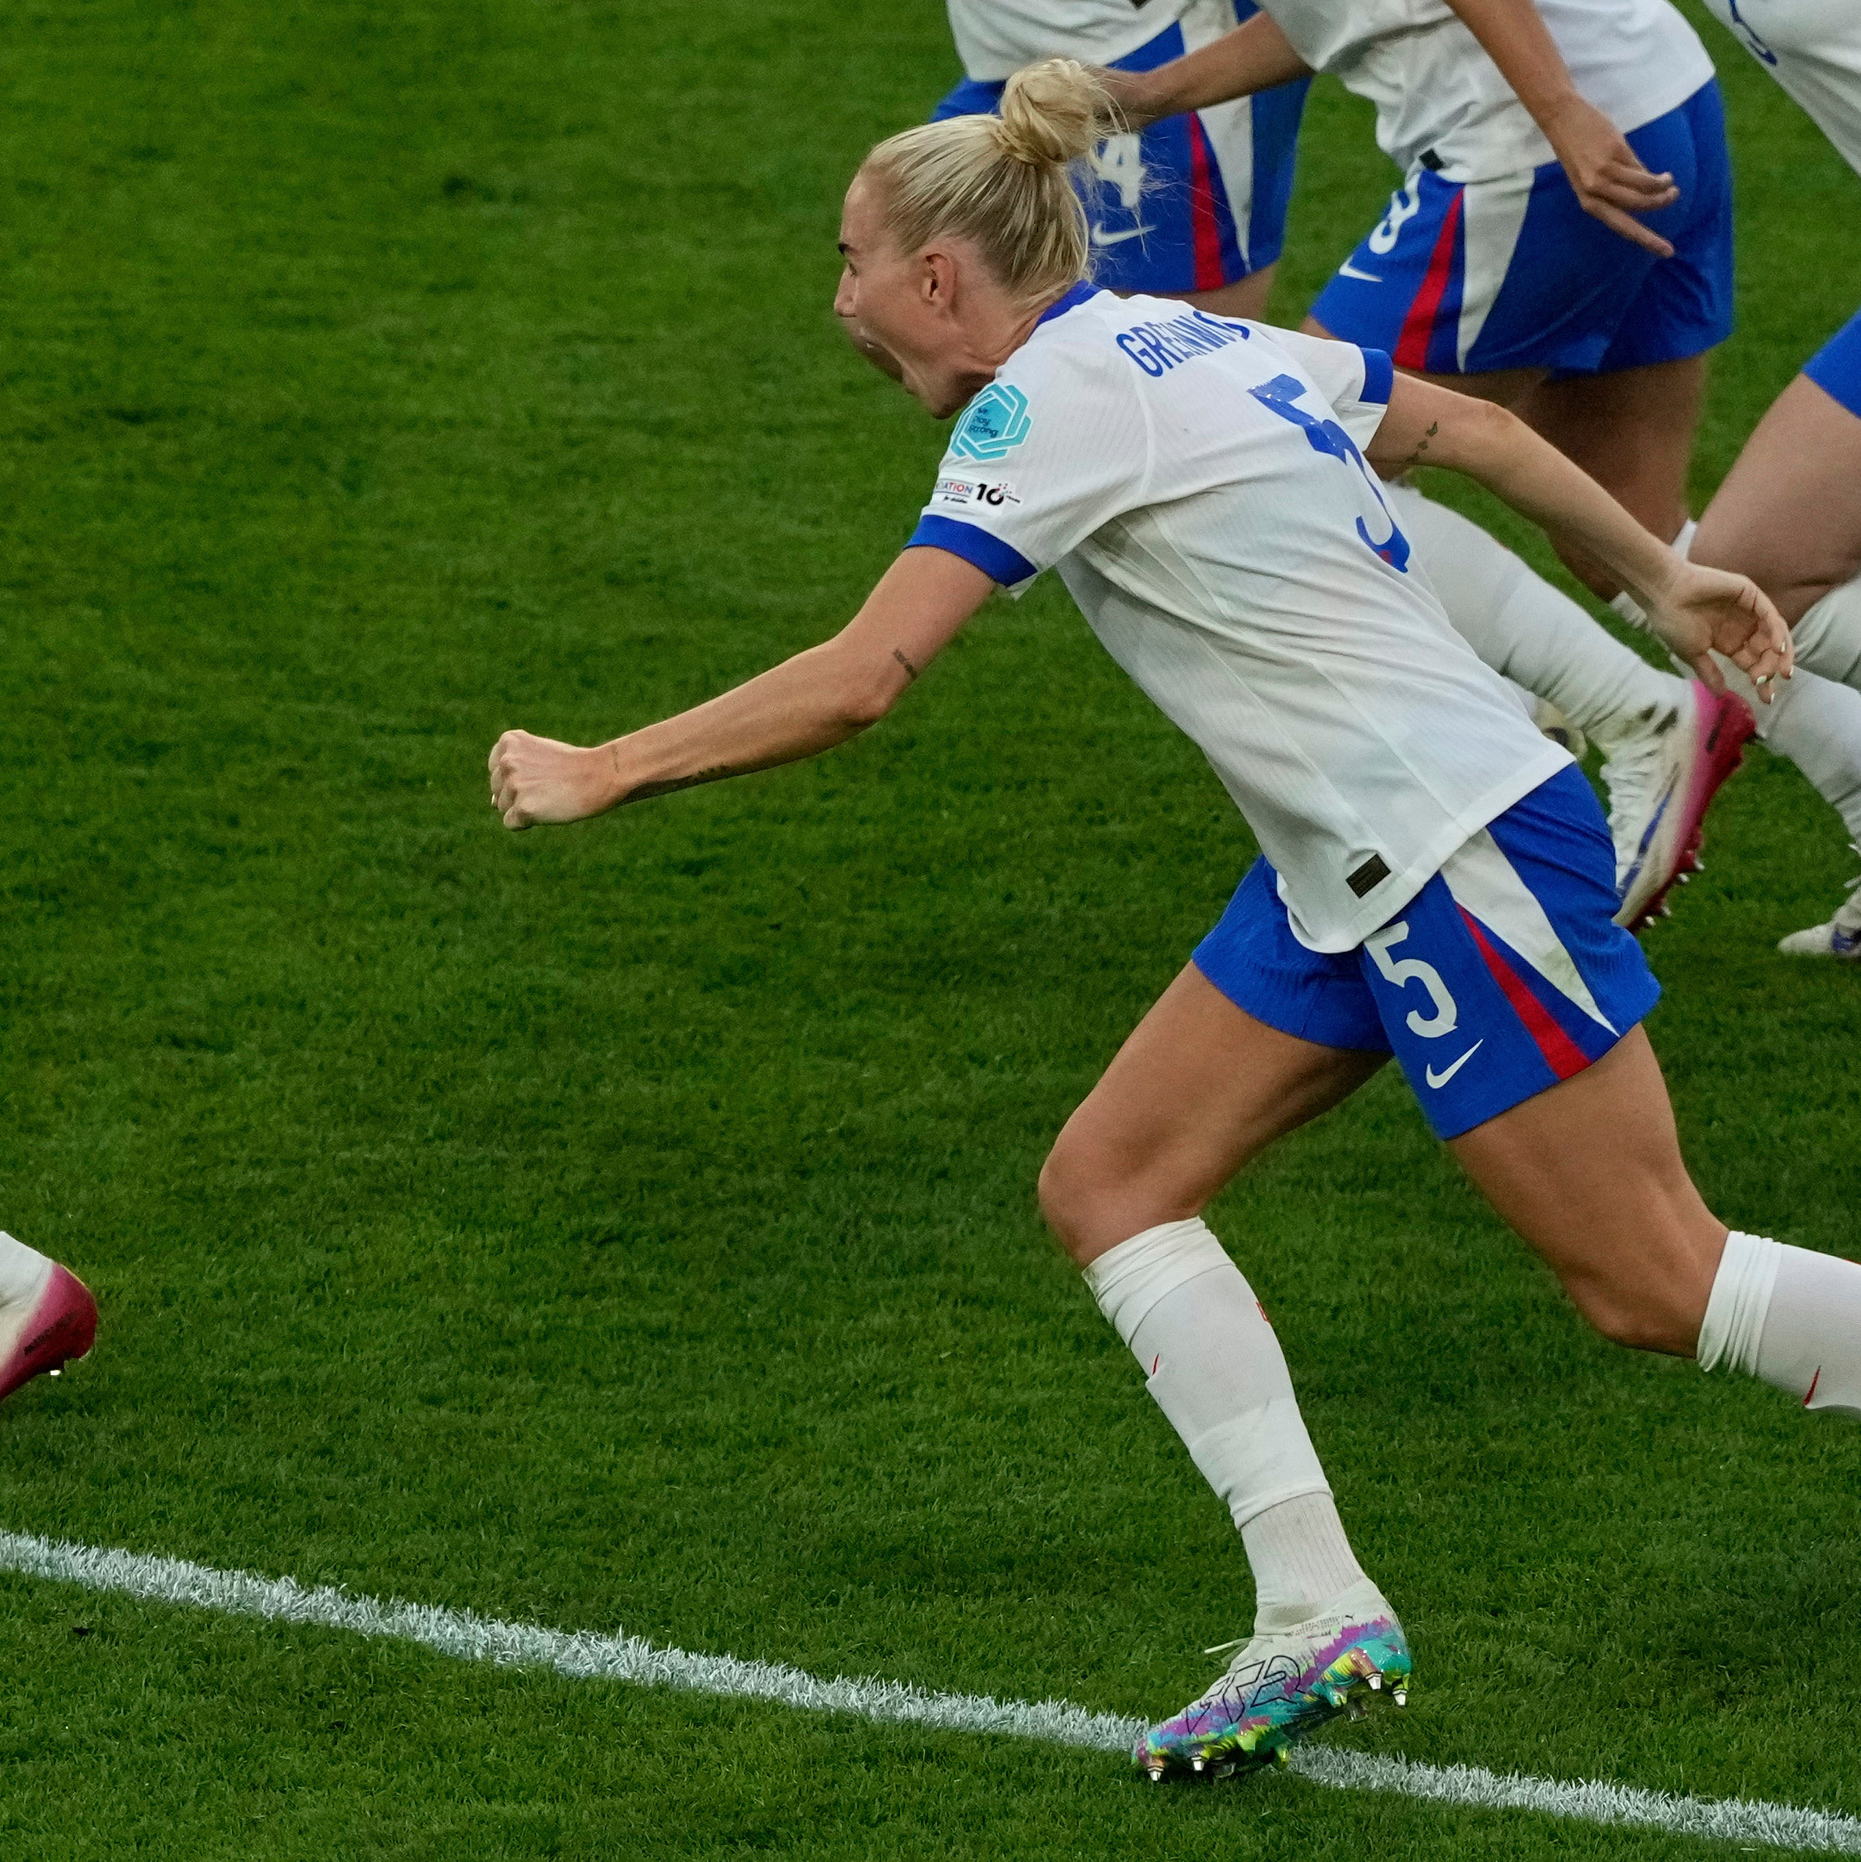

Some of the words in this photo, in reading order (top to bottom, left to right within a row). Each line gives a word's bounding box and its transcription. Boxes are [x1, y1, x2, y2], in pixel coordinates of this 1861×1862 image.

[1099, 131, 1147, 209] 4
[975, 482, 1005, 506] 10
[1247, 374, 1410, 574] 5
[1364, 921, 1458, 1038] 5
